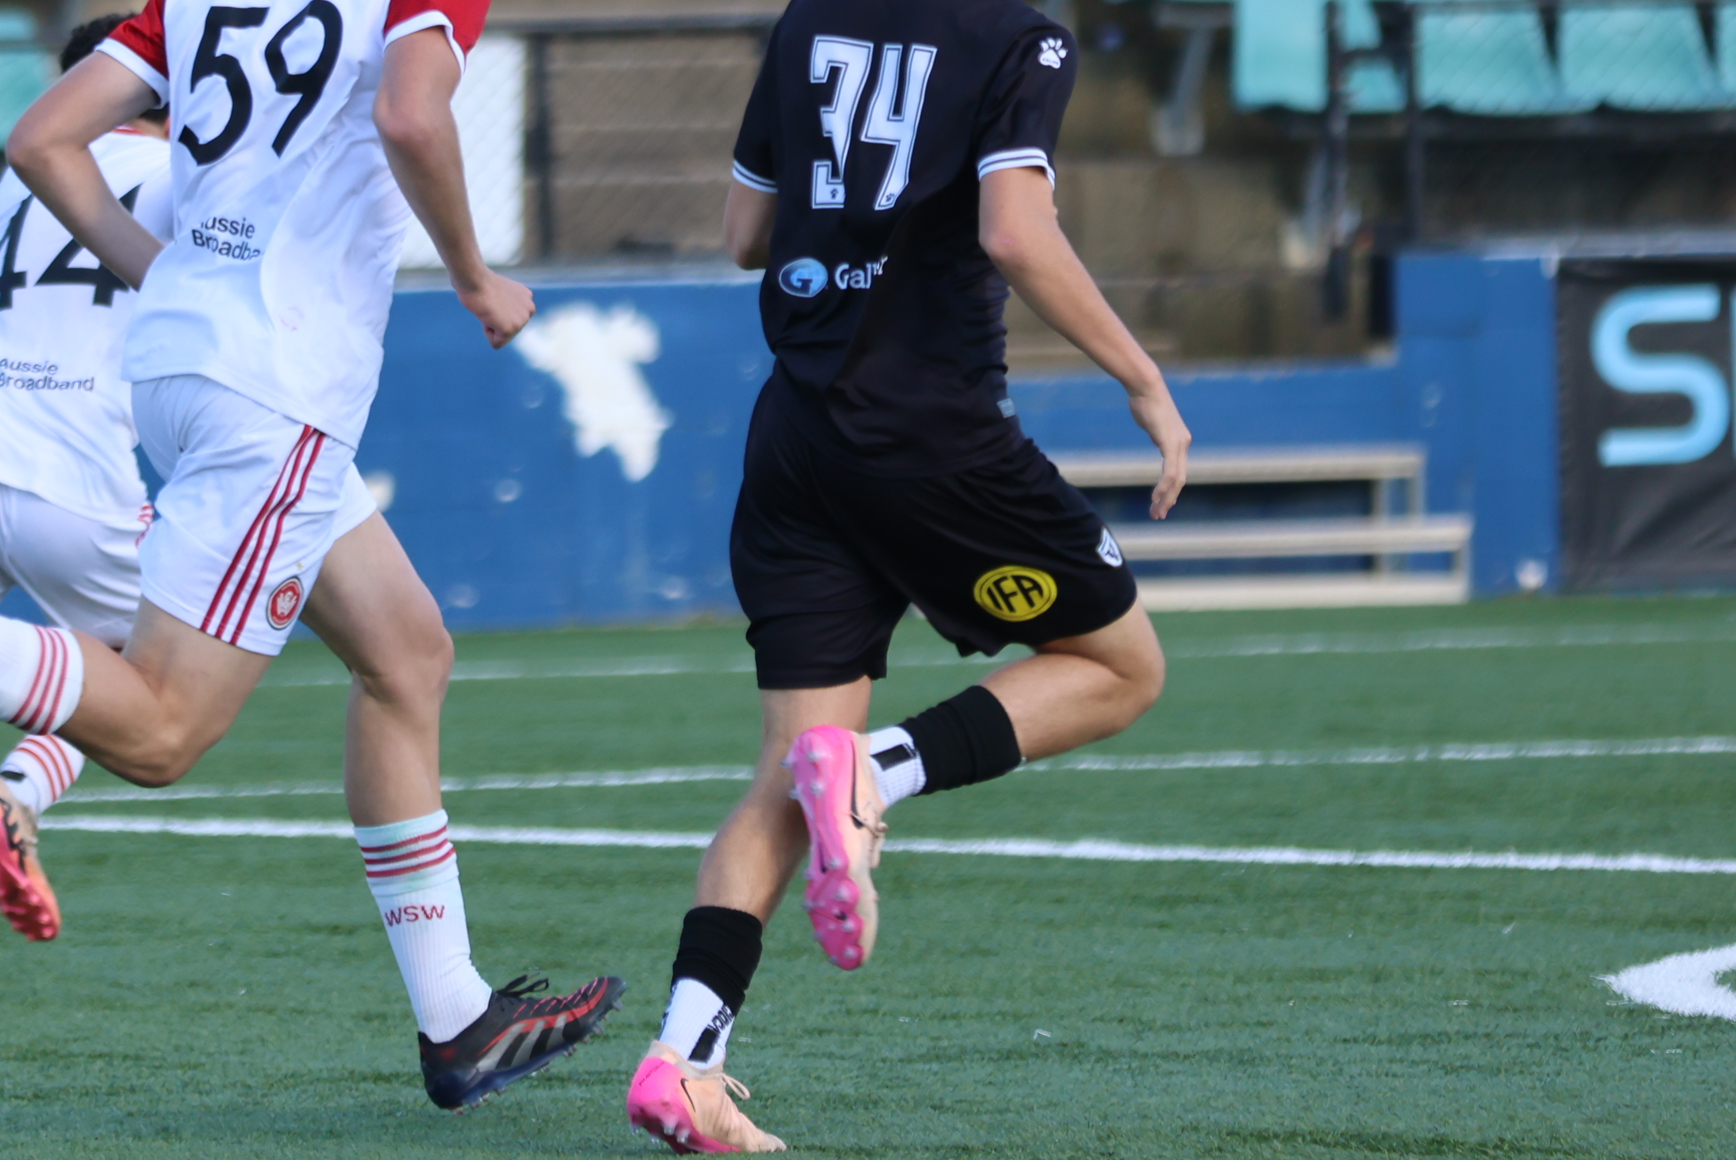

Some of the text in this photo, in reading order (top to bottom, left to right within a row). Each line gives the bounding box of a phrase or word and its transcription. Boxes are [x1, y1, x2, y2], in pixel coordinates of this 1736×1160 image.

[809, 34, 938, 211] 34
[200, 216, 255, 239] ussie
[1589, 283, 1736, 467] S
[986, 574, 1045, 614] IFA
[384, 904, 446, 928] WSW
